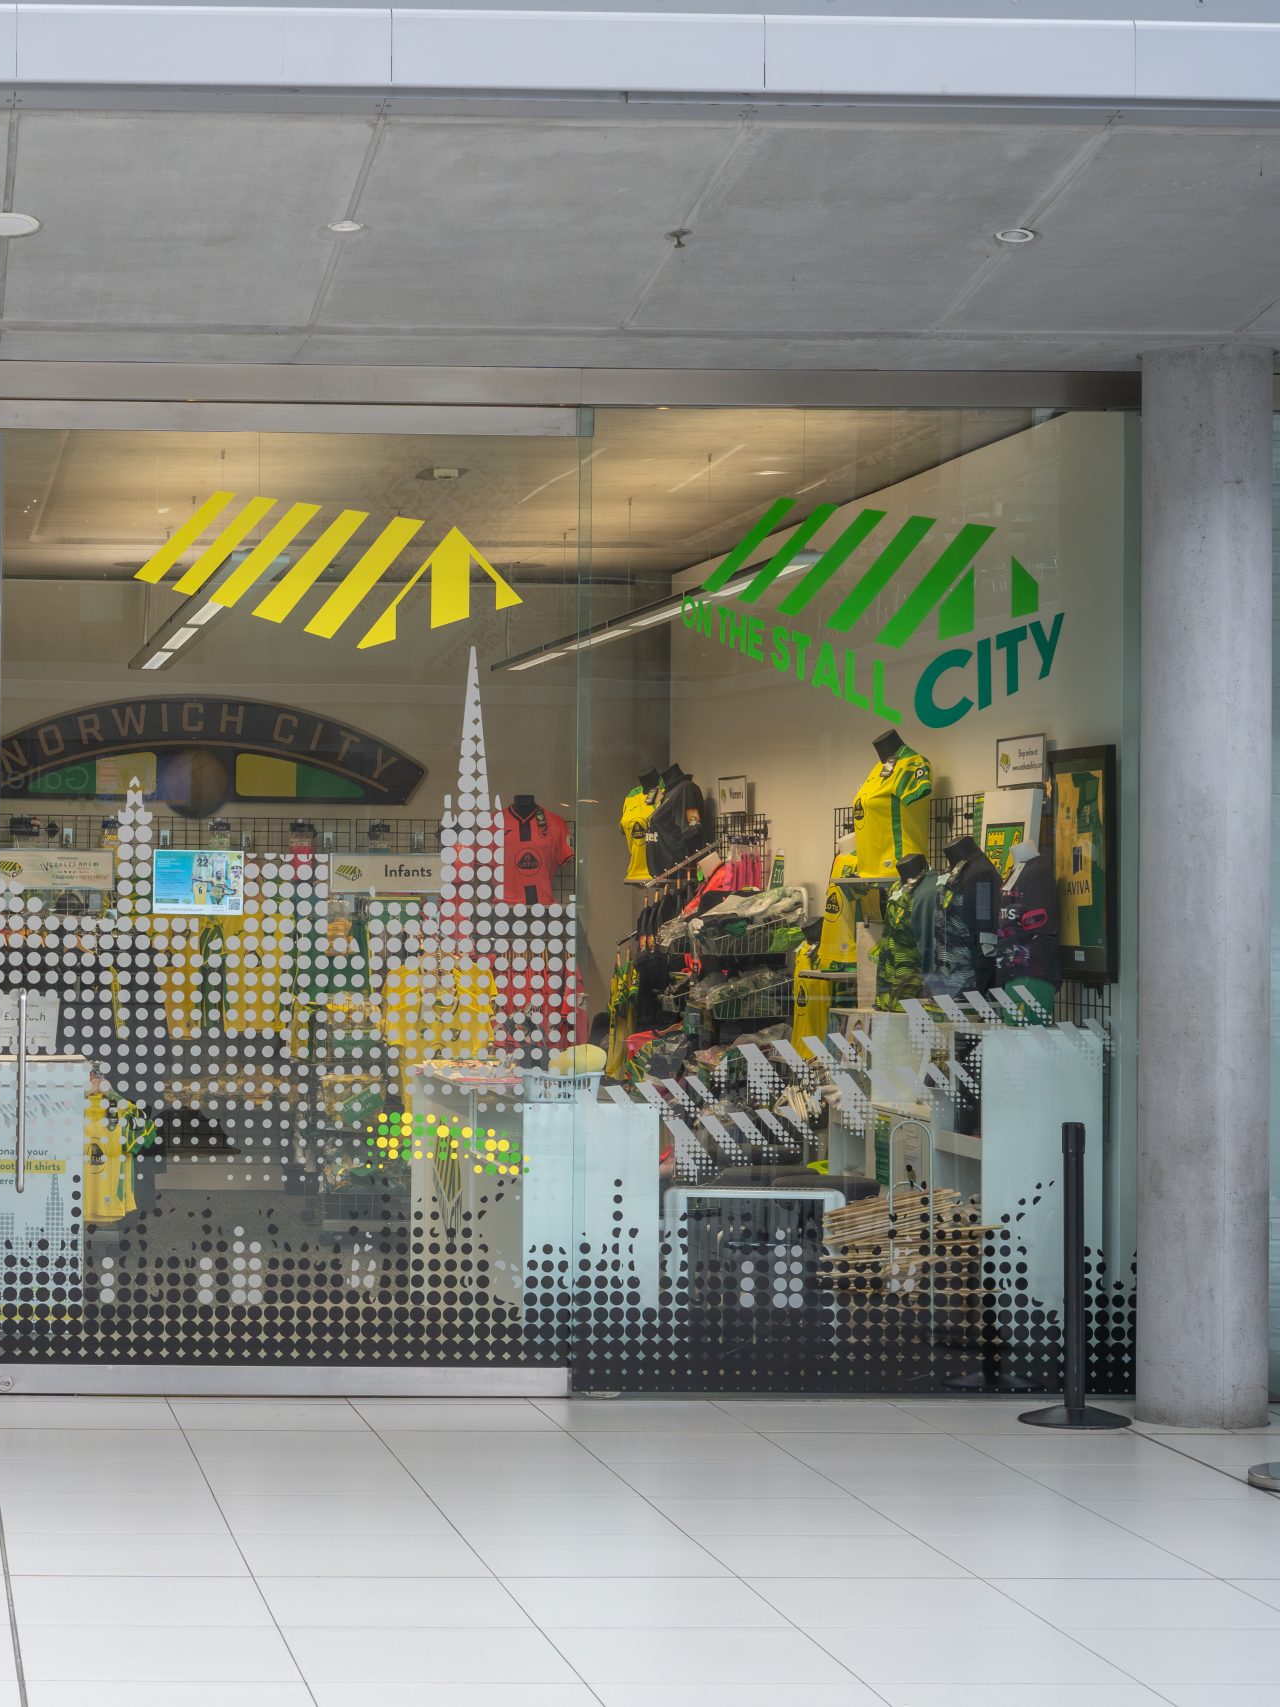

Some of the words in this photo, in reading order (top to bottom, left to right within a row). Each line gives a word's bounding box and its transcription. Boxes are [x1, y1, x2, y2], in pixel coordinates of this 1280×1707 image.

[681, 594, 713, 639] ON
[717, 605, 765, 663] THE
[771, 625, 902, 726] STALL
[914, 612, 1065, 729] CITY
[1, 702, 246, 775] NORWICH
[272, 714, 398, 780] CITY
[197, 858, 208, 867] 22
[384, 863, 433, 878] Infants
[199, 886, 203, 894] 6
[1066, 879, 1090, 896] AVIVA
[27, 1149, 48, 1158] your
[34, 1161, 61, 1171] shirts
